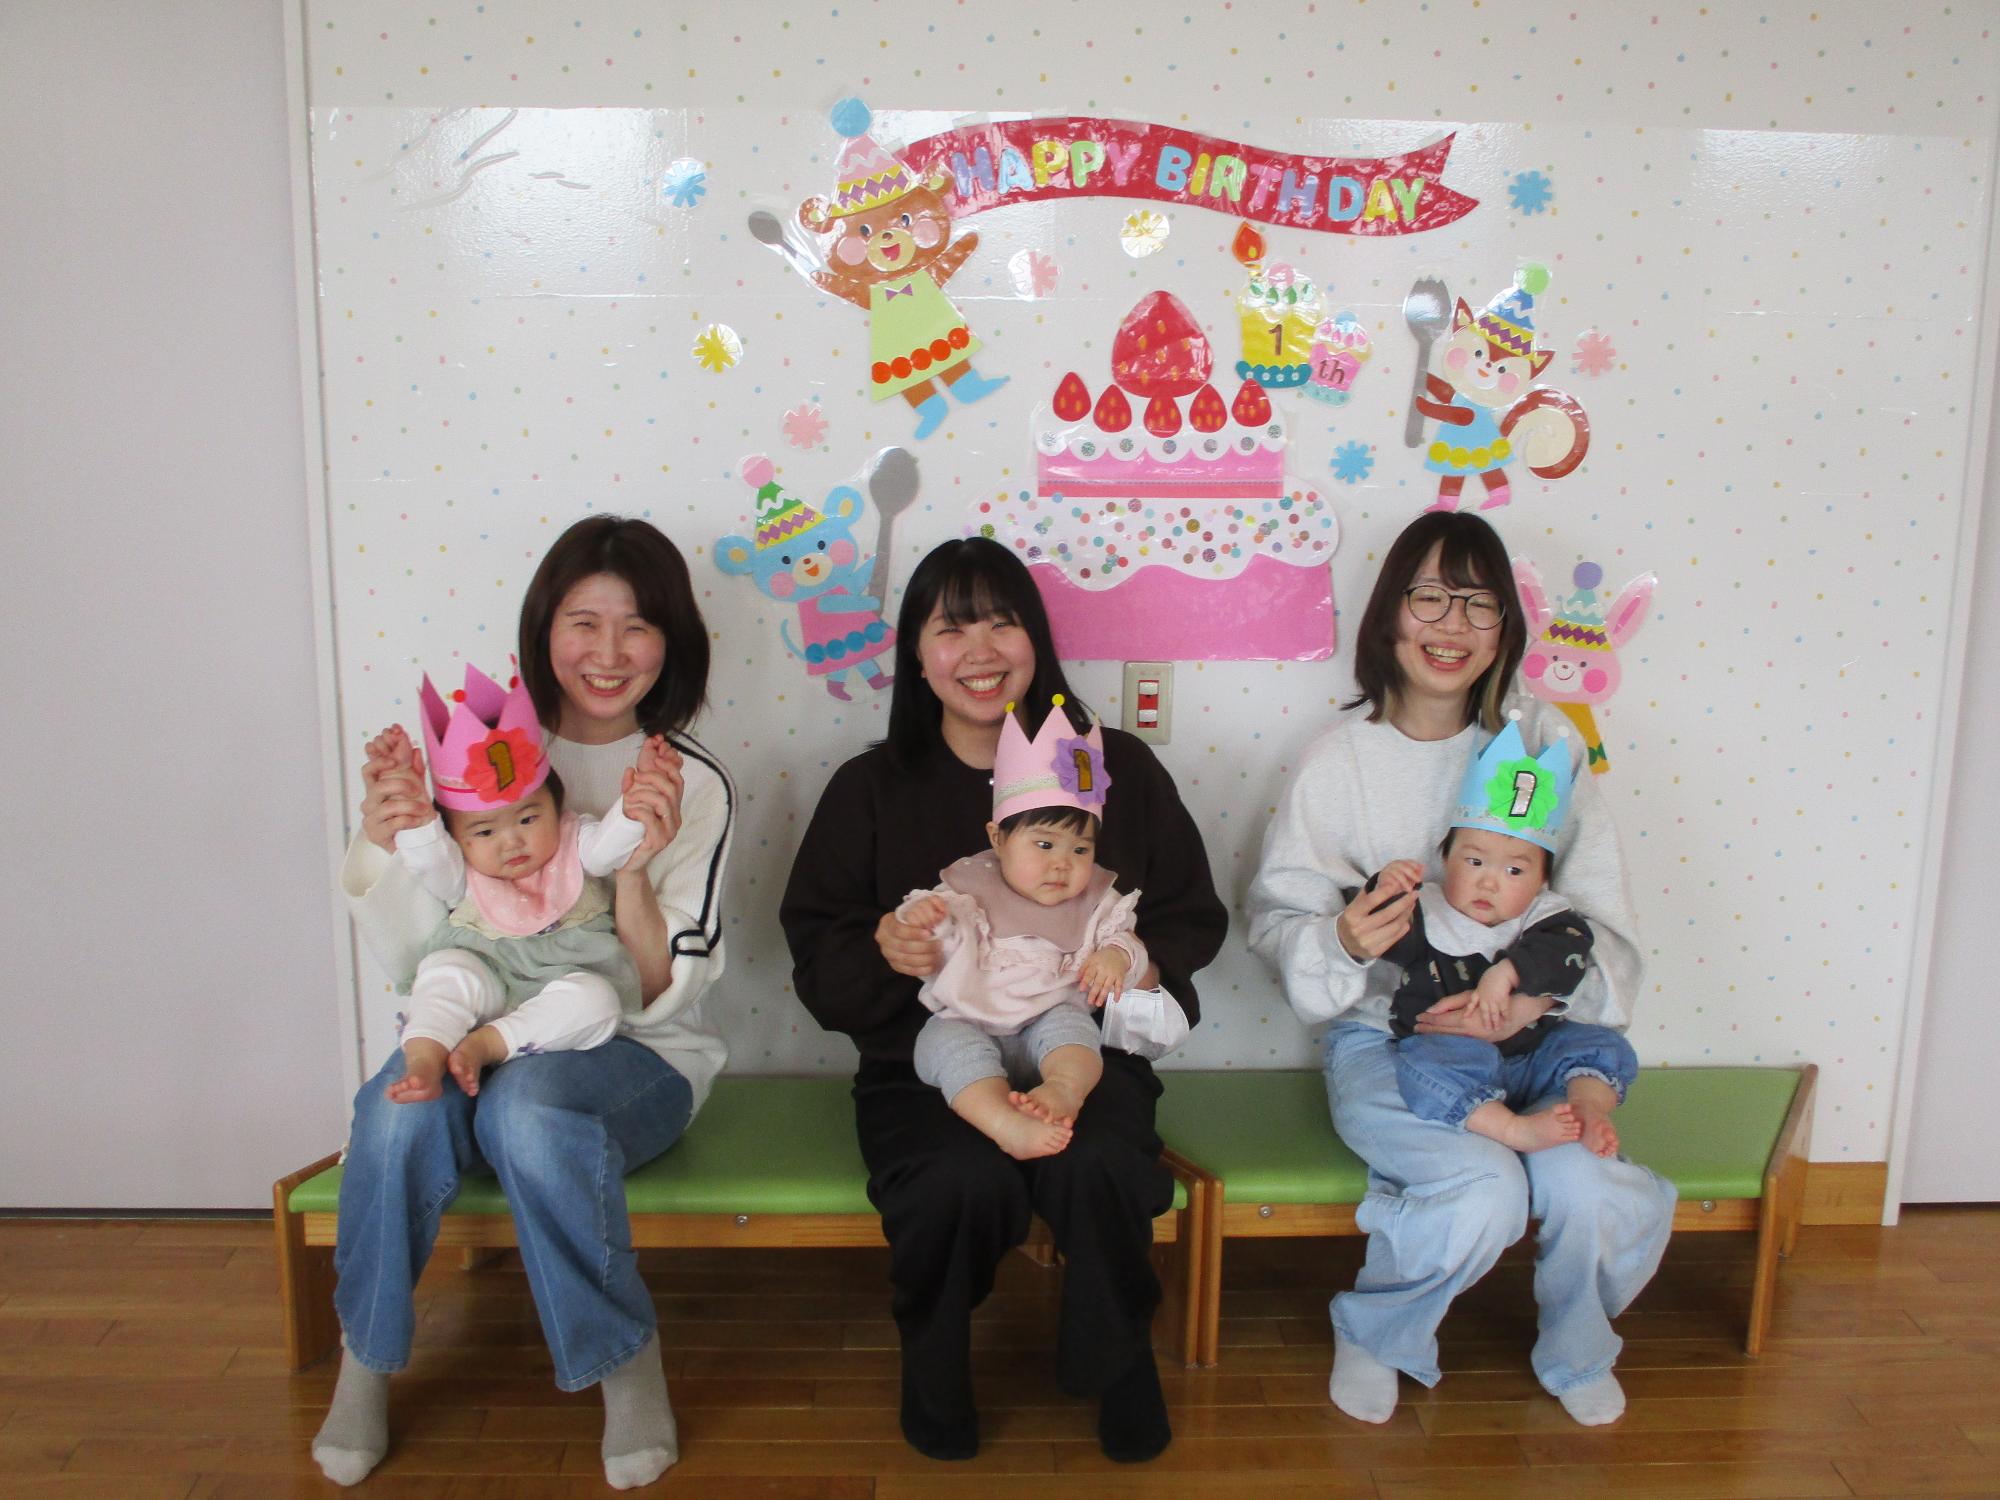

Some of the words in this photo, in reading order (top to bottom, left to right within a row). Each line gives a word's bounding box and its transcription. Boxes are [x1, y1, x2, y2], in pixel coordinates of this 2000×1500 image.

[952, 141, 1142, 196] HAPPY
[1155, 146, 1425, 222] BIRTHDAY
[1268, 324, 1283, 356] 1
[1318, 358, 1346, 384] th
[486, 741, 516, 793] 1
[1073, 748, 1093, 792] 1
[1508, 770, 1538, 818] 1
